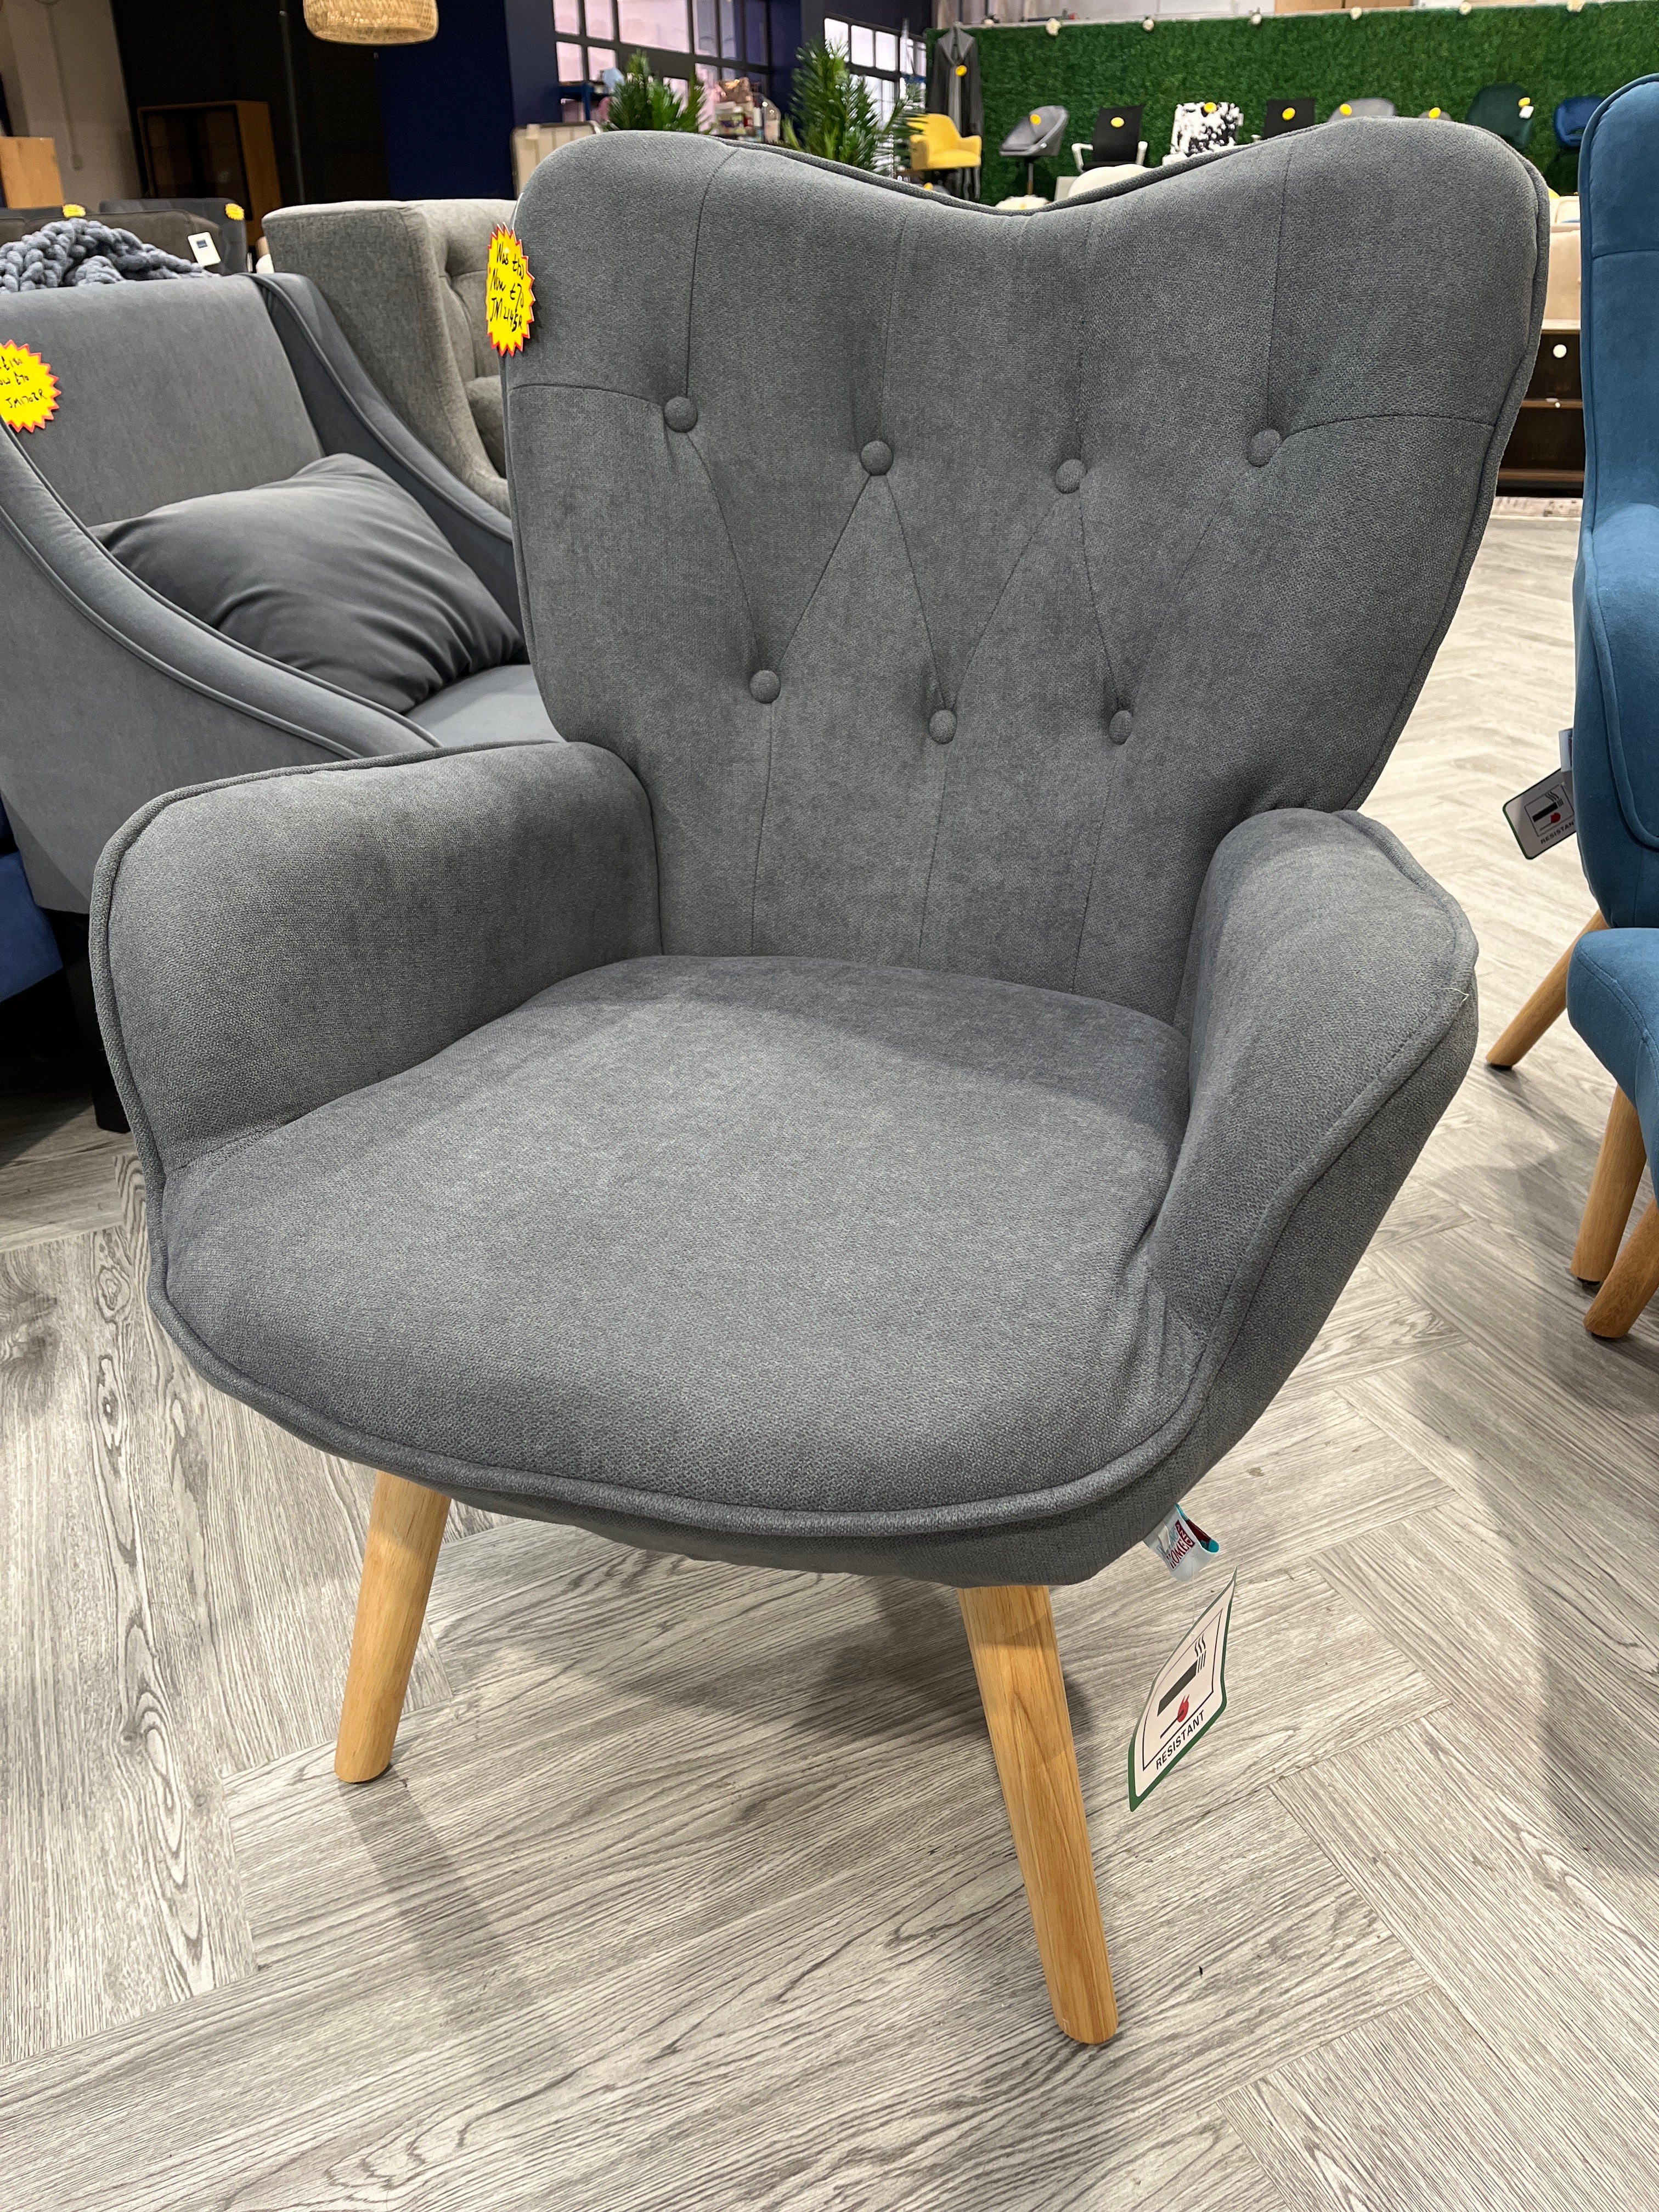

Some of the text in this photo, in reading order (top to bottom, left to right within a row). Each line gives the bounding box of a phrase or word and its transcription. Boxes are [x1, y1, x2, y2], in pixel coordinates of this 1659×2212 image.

[496, 241, 509, 265] Was
[490, 268, 506, 291] Now
[1166, 1538, 1190, 1569] HOME
[1155, 1709, 1205, 1770] RESISTANT
